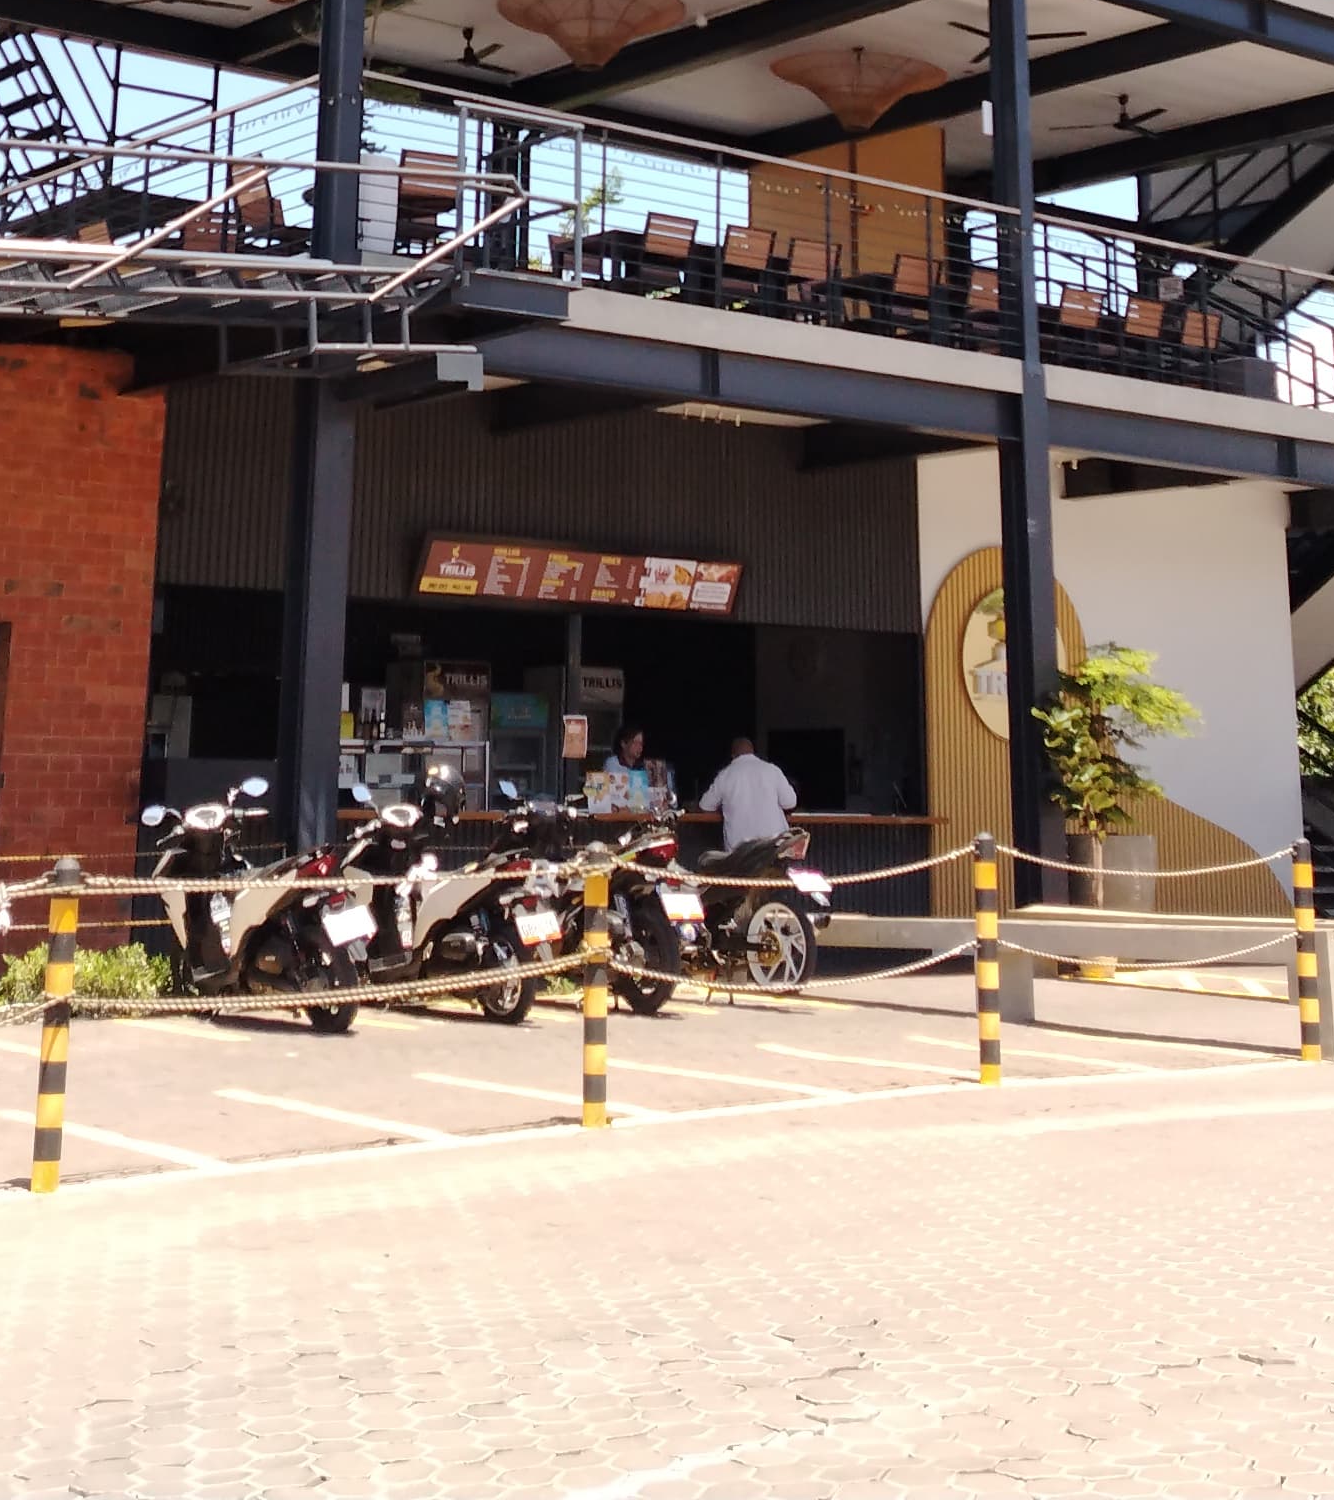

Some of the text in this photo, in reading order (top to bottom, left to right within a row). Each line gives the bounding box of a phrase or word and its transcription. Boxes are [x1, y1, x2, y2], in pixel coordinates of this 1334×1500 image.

[439, 563, 476, 577] TRILLIS
[444, 672, 488, 687] TRILLIS
[582, 674, 623, 688] TRILLIS
